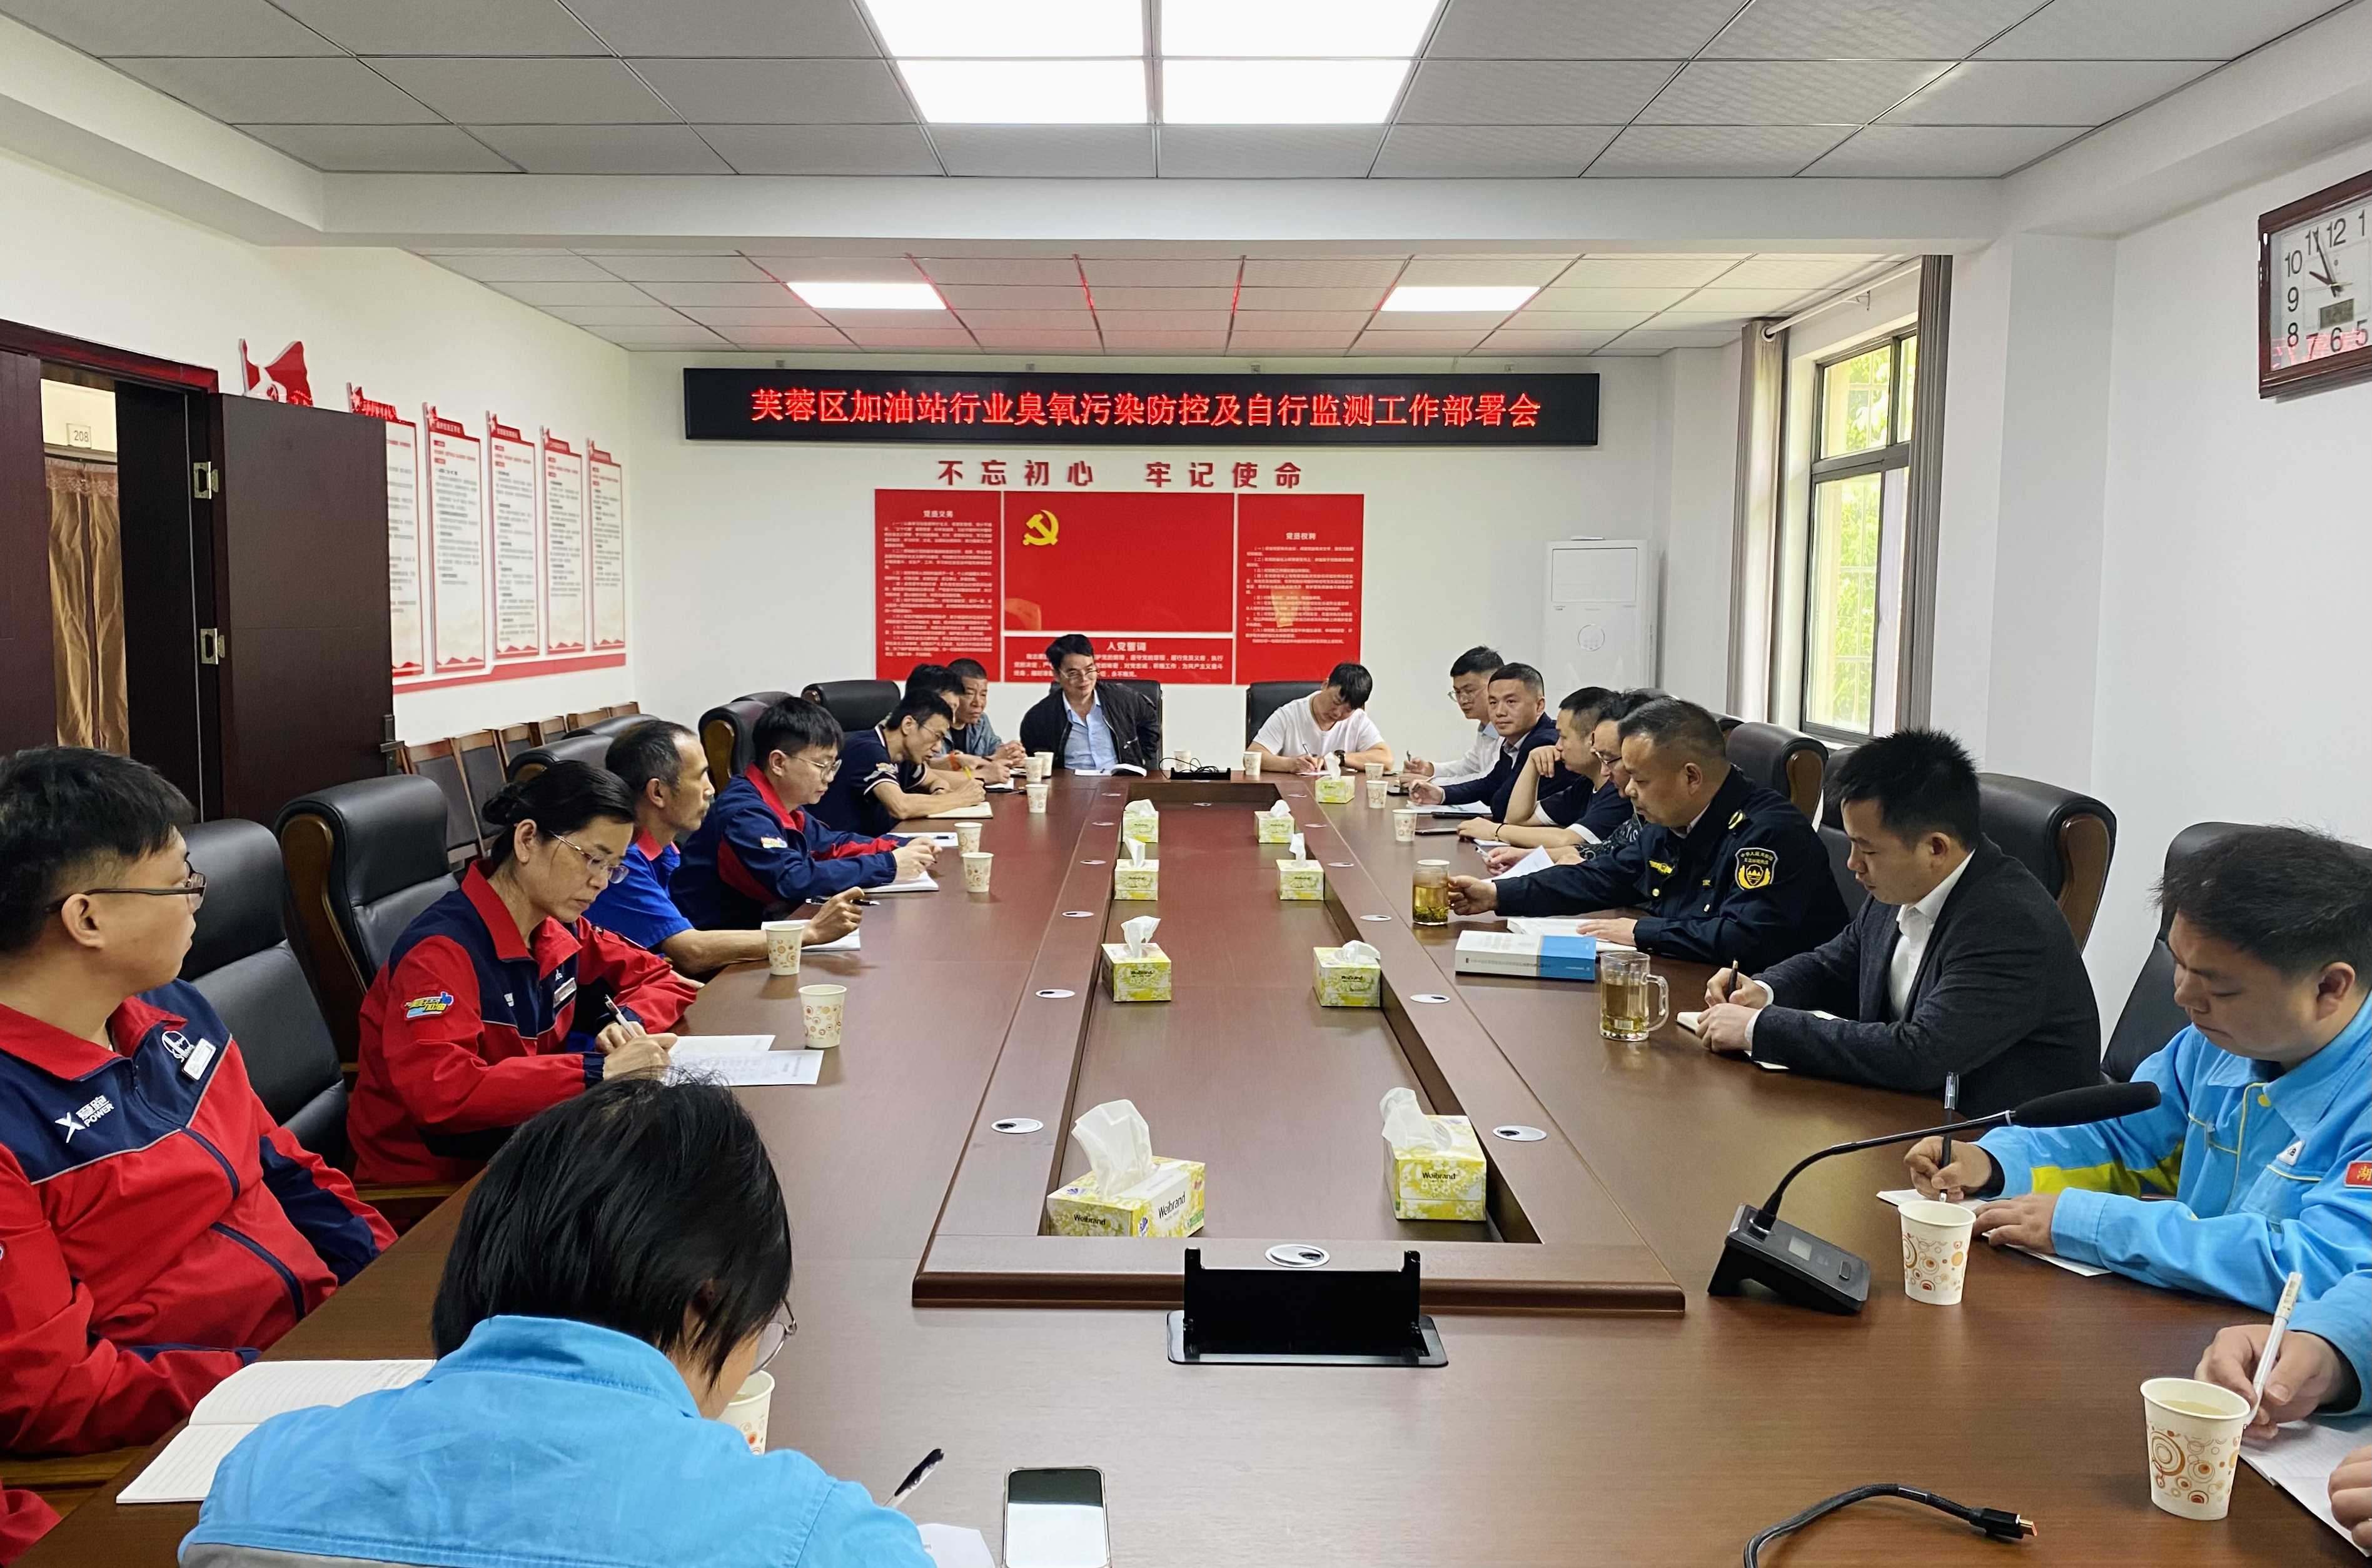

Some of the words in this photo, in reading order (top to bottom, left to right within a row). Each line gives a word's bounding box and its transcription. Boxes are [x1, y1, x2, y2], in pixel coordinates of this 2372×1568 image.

[2327, 218, 2346, 248] 12
[2359, 211, 2364, 236] 1
[2305, 228, 2321, 256] 11
[2285, 250, 2302, 277] 10
[2288, 286, 2299, 313] 9
[2287, 322, 2299, 348] 8
[2330, 326, 2343, 353] 6
[2355, 319, 2368, 346] 5
[2306, 333, 2319, 360] 7
[751, 388, 1541, 427] 芙蓉区加油站行业臭氧污染防控及自行监测工作部署会
[73, 430, 89, 443] 208
[937, 460, 1093, 487] 不忘初心
[1145, 461, 1301, 489] 牢记使命
[1286, 532, 1316, 540] 党员权利
[1106, 641, 1146, 652] 入党誓词
[84, 1103, 114, 1128] POWER
[1158, 1192, 1186, 1219] Weibrand
[1074, 1214, 1106, 1226] Weibrand
